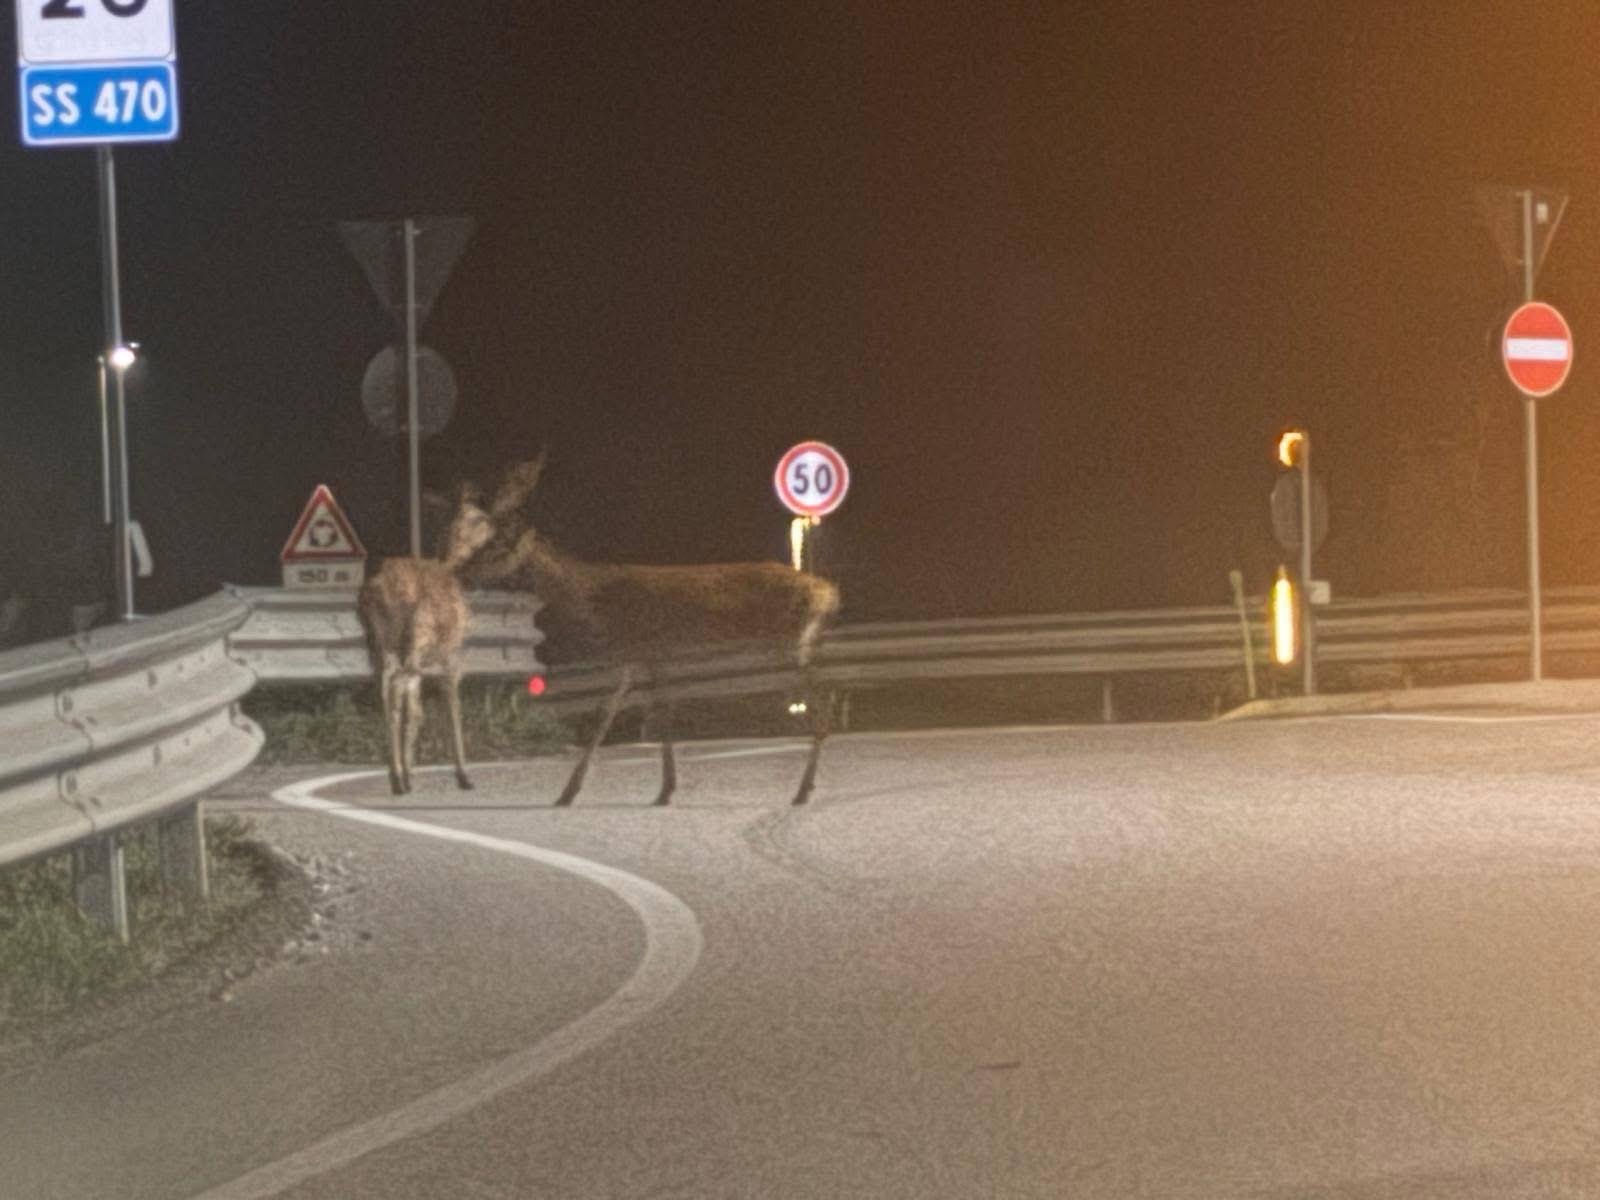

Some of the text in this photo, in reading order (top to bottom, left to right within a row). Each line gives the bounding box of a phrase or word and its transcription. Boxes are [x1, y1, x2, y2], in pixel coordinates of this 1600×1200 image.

[31, 79, 167, 126] SS 470
[792, 463, 832, 494] 50
